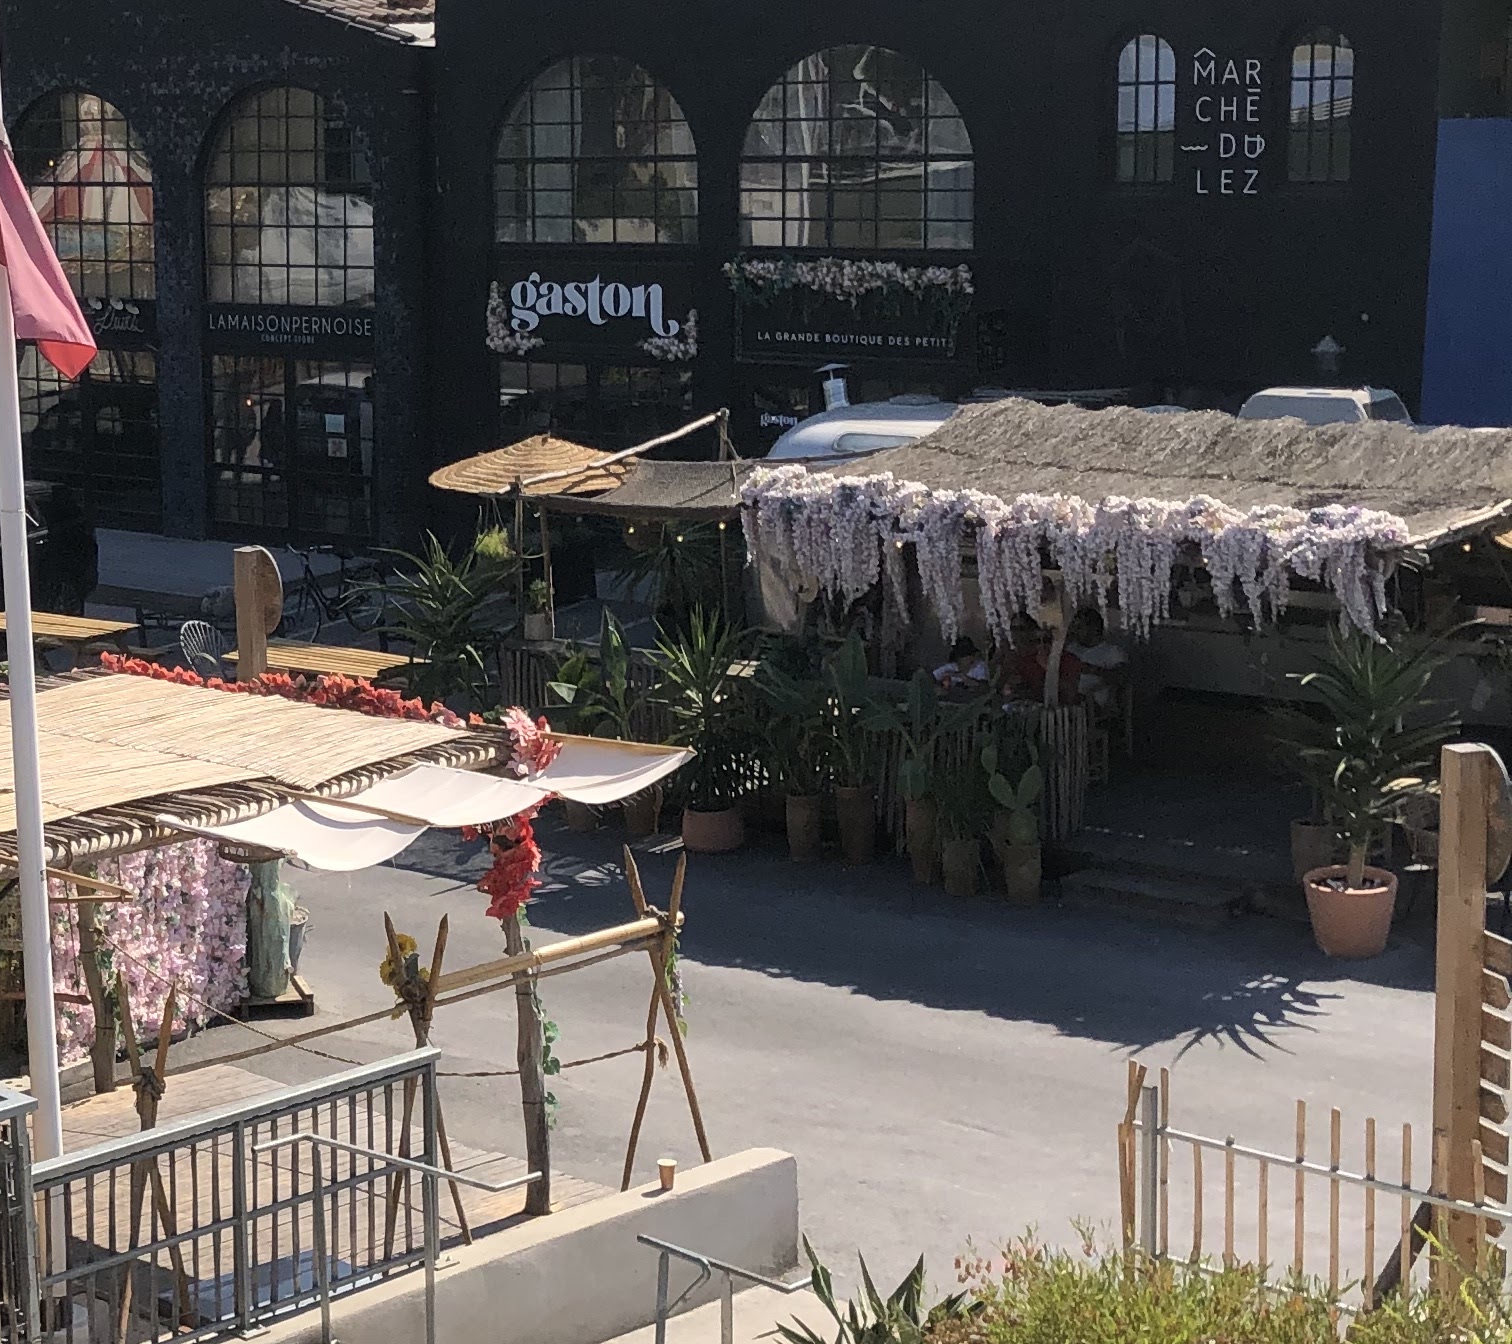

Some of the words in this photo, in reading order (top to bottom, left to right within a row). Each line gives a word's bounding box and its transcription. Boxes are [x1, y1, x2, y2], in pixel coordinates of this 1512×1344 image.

[1196, 169, 1259, 194] LEZ
[510, 271, 680, 337] gaston
[208, 313, 372, 336] LAMAISONPERNOISE
[757, 331, 771, 341] LA
[775, 331, 820, 343] GRANDE
[825, 333, 883, 346] BOUTIQUE
[888, 336, 910, 347] DES
